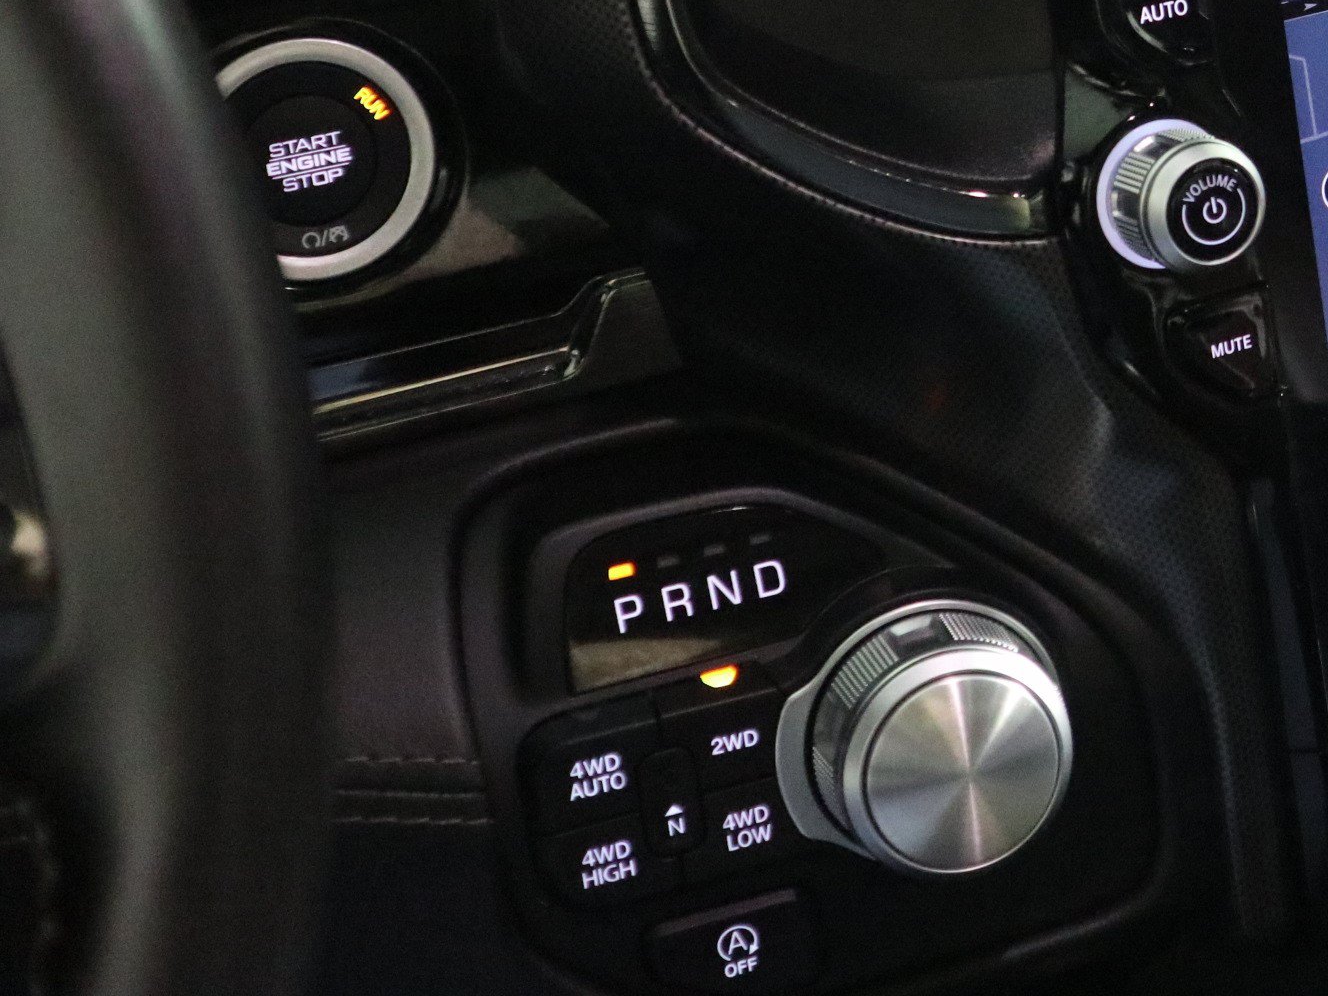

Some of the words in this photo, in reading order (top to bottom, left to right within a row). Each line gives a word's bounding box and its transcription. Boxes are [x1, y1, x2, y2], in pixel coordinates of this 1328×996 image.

[353, 86, 391, 121] RUN
[268, 130, 341, 158] START
[265, 146, 353, 177] ENGINE
[283, 167, 345, 193] STOP
[1182, 172, 1238, 204] VOLUME
[1210, 333, 1252, 360] MUTE
[613, 594, 644, 634] P
[661, 583, 694, 622] R
[706, 569, 744, 610] N
[753, 559, 787, 599] D
[710, 728, 760, 757] 2WD
[569, 753, 622, 781] 4WD
[569, 772, 627, 802] AUTO
[667, 817, 687, 837] N
[722, 804, 770, 833] 4WD
[726, 824, 773, 852] LOW
[581, 840, 633, 868] 4WD
[581, 860, 637, 890] HIGH
[723, 958, 758, 979] OFF
